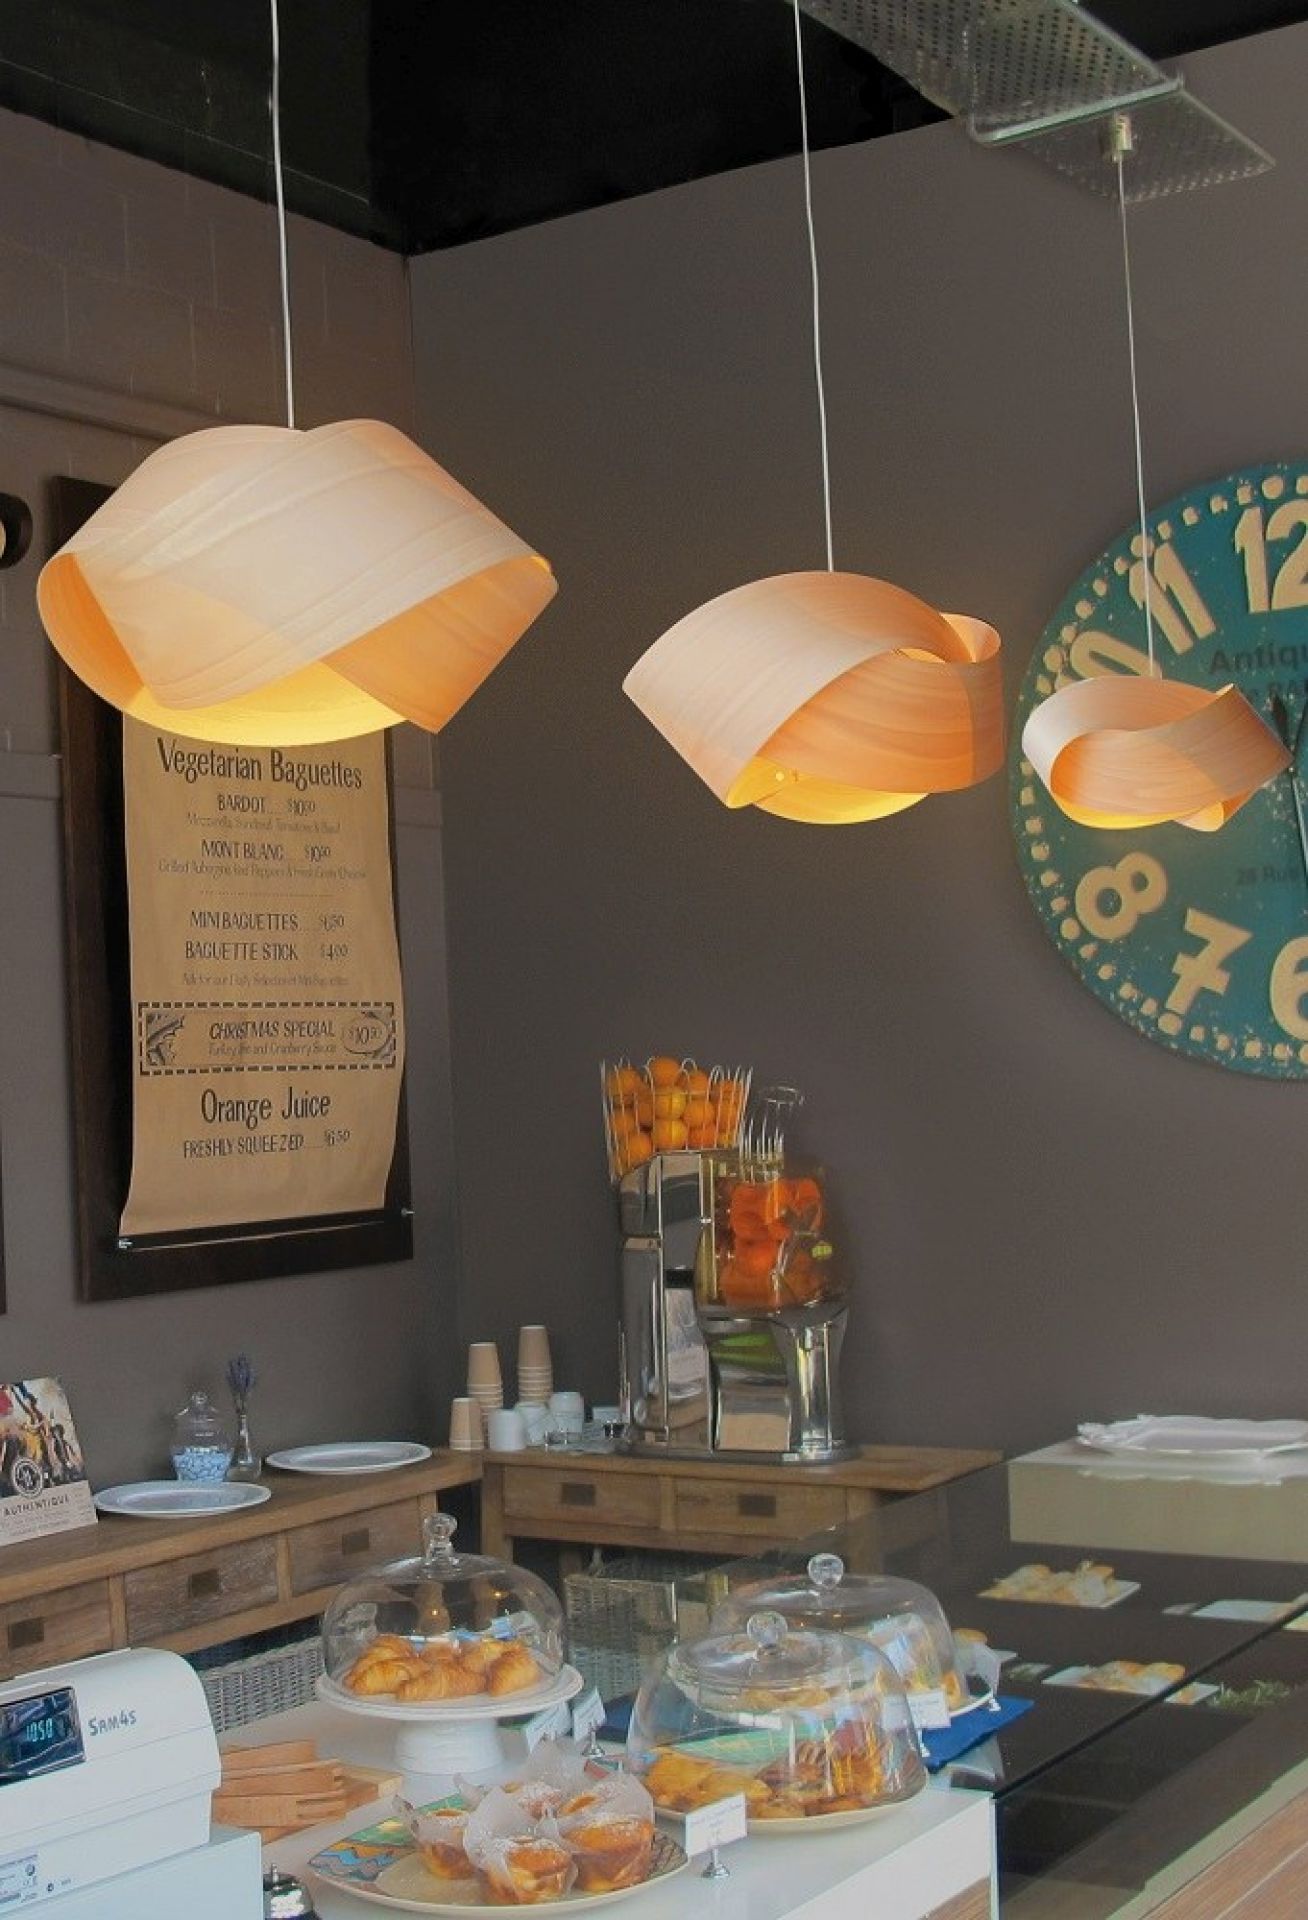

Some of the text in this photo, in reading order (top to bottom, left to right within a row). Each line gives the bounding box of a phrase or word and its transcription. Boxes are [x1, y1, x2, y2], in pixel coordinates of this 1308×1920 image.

[1235, 499, 1308, 613] 12
[1129, 543, 1216, 655] 11
[157, 737, 363, 791] Vegetarian Baguettes
[217, 794, 266, 812] BARDOT
[201, 839, 239, 859] MONT
[243, 843, 284, 861] BLANC
[1075, 850, 1168, 940] 8
[190, 911, 220, 929] MINI
[222, 912, 299, 931] BAGUETTES
[185, 940, 258, 960] BAGUETTE
[262, 942, 298, 961] STICK
[1165, 908, 1254, 1015] 7
[209, 1021, 279, 1041] CHRISTMAS
[283, 1020, 336, 1038] SPECIAL
[201, 1086, 331, 1130] Orange Juice
[184, 1138, 233, 1158] FRESHLY
[237, 1133, 304, 1156] SQUEEZED
